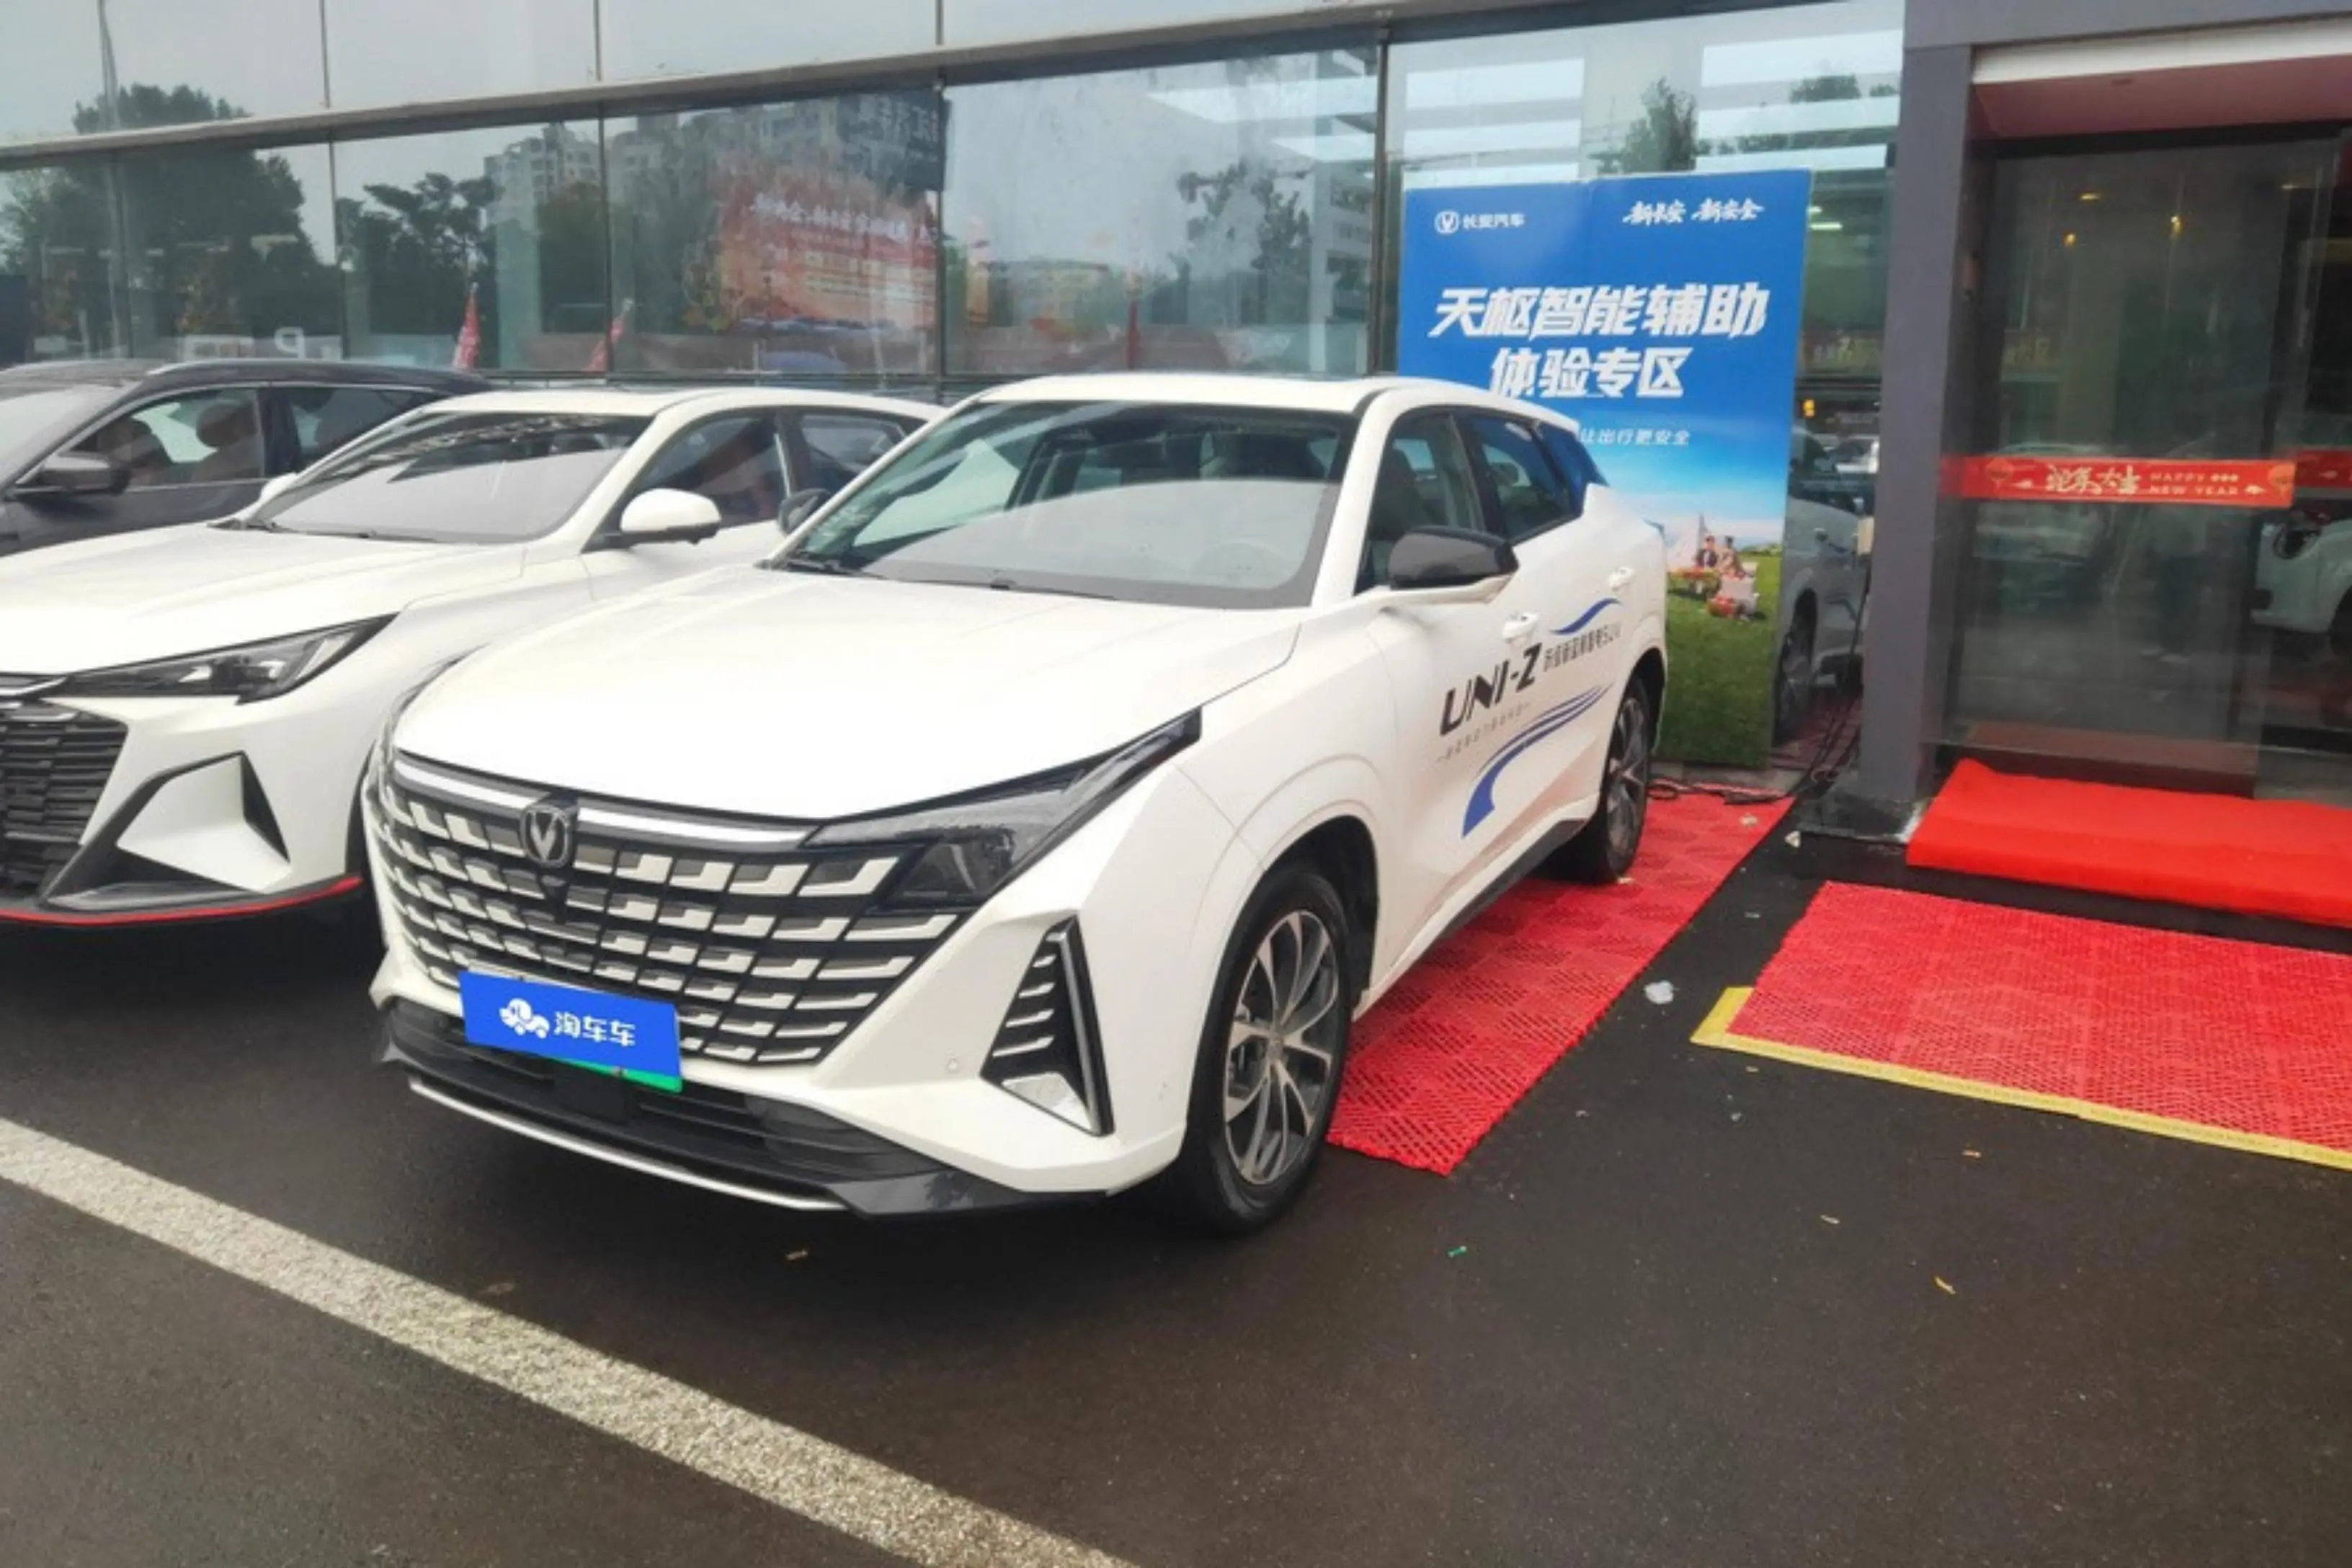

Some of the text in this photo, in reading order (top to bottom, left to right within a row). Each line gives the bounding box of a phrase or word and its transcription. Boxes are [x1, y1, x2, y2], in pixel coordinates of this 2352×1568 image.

[1462, 213, 1525, 230] 长安汽车
[1428, 281, 1770, 342] 天枢智能辅助
[1489, 347, 1693, 398] 体验专区
[2149, 485, 2238, 496] NEW YEAR
[2150, 472, 2205, 483] HAPPY
[1439, 643, 1542, 736] UNI-Z
